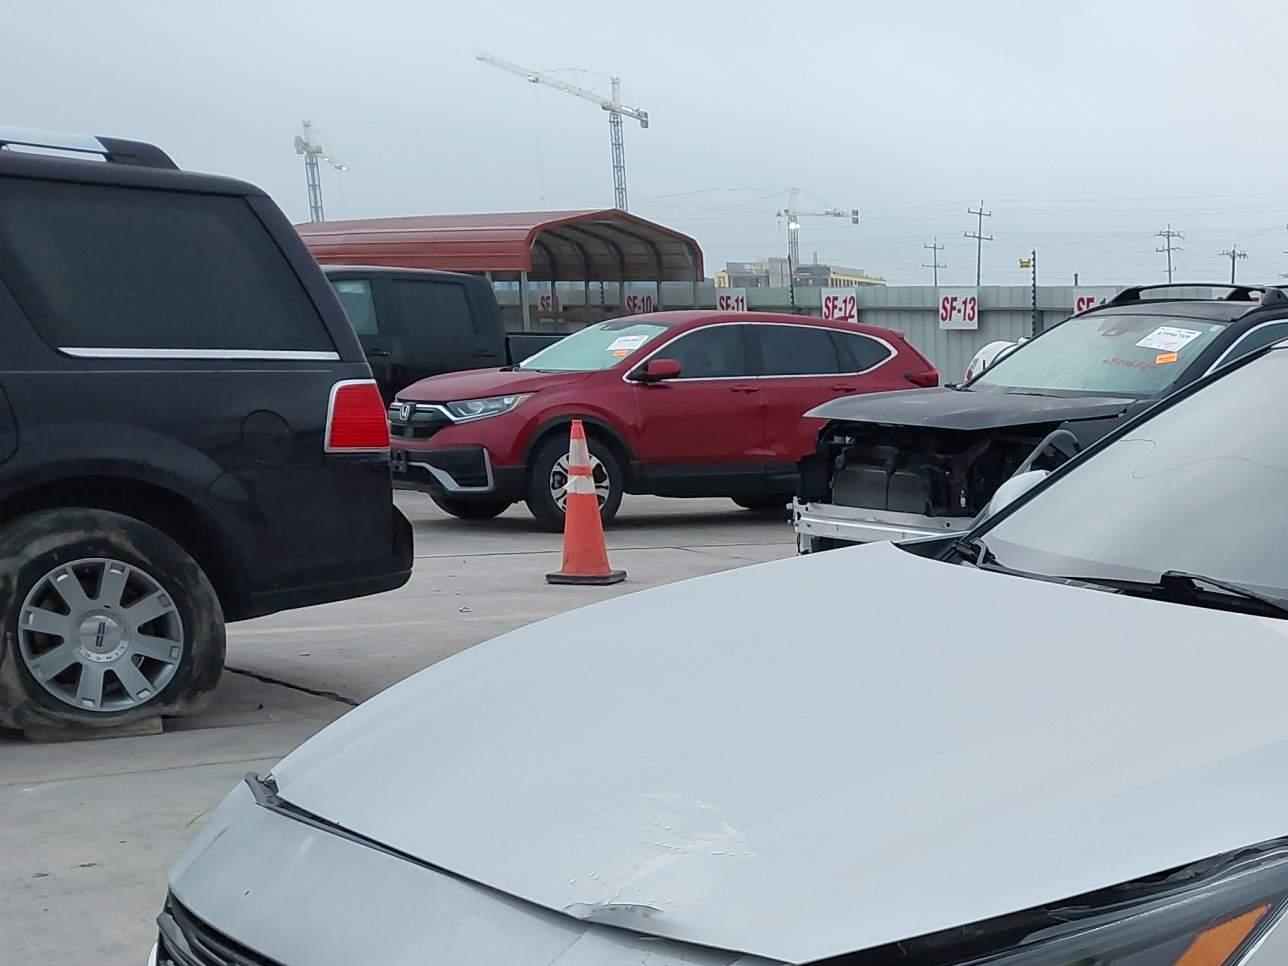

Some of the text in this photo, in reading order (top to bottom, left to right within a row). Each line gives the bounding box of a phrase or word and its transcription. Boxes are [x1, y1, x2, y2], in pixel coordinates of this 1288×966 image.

[626, 296, 652, 313] SF-10
[719, 296, 745, 311] SF-11
[824, 296, 855, 319] SF-12
[941, 296, 976, 321] SF-13
